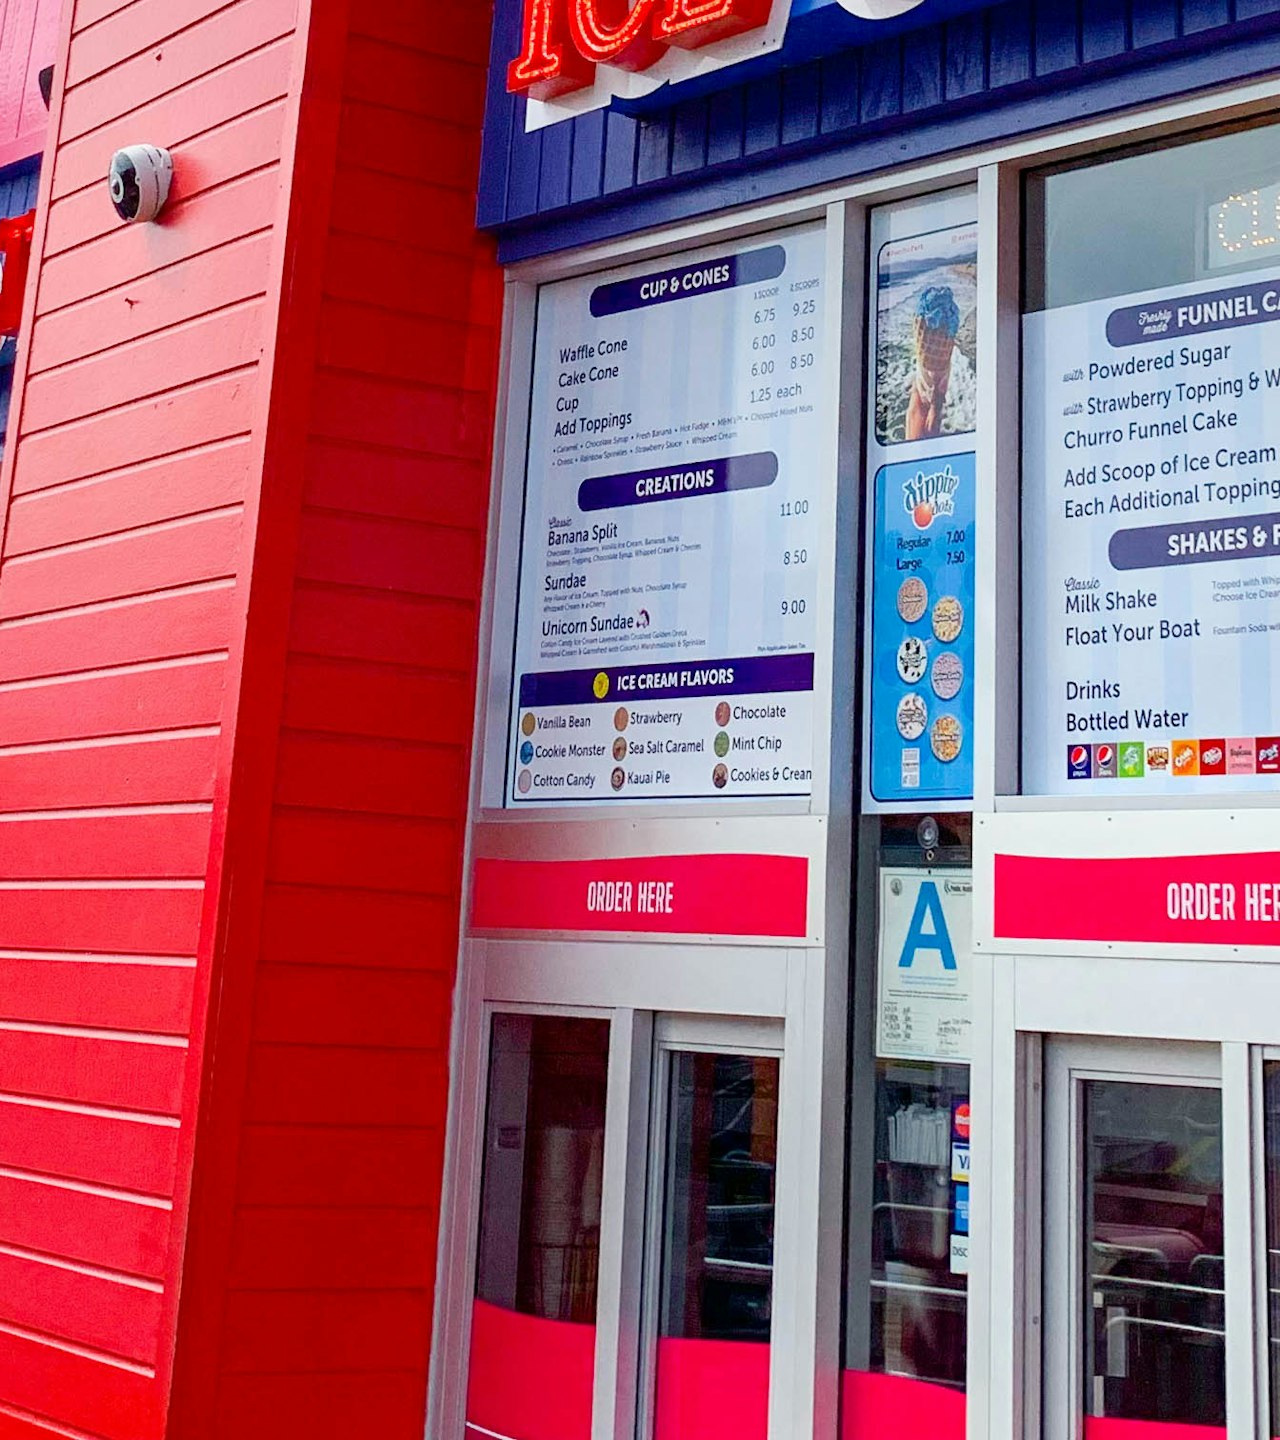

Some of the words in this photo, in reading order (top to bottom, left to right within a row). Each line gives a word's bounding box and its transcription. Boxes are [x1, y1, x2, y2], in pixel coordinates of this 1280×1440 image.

[640, 278, 667, 300] CUP
[670, 276, 679, 292] &
[682, 264, 729, 291] CONES
[1177, 295, 1258, 328] FUNNEL
[560, 347, 595, 364] Waffle
[598, 338, 628, 355] Cone
[752, 334, 775, 350] 6.00
[791, 327, 814, 342] 8.50
[751, 361, 774, 377] 6.00
[790, 354, 813, 369] 8.50
[1089, 352, 1175, 381] Powdered
[1180, 343, 1232, 371] Sugar
[558, 371, 585, 387] Cake
[588, 365, 619, 382] Cone
[556, 397, 579, 414] Cup
[750, 388, 771, 403] 1.25
[777, 383, 802, 399] each
[1087, 386, 1172, 417] Strawberry
[1175, 376, 1244, 406] Topping
[1248, 372, 1260, 391] &
[554, 422, 576, 437] Add
[580, 411, 632, 433] Toppings
[1064, 427, 1123, 450] Churro
[1128, 418, 1188, 442] Funnel
[1191, 410, 1238, 433] Cake
[1063, 468, 1097, 488] Add
[1101, 460, 1155, 487] Scoop
[1160, 456, 1180, 475] of
[1184, 452, 1209, 473] Ice
[1215, 444, 1277, 469] Cream
[636, 469, 714, 497] CREATIONS
[1064, 497, 1105, 519] Each
[1109, 488, 1199, 514] Additional
[548, 530, 589, 546] Banana
[592, 523, 618, 543] Split
[1167, 528, 1247, 557] SHAKES
[1252, 525, 1267, 547] &
[783, 549, 807, 565] 8.50
[544, 573, 586, 591] Sundae
[781, 599, 806, 615] 9.00
[1065, 594, 1101, 614] Milk
[1105, 590, 1157, 610] Shake
[542, 617, 587, 637] Unicorn
[590, 612, 634, 631] Sundae
[1065, 624, 1107, 647] Float
[1112, 623, 1155, 643] Your
[1159, 618, 1201, 639] Boat
[617, 675, 635, 691] ICE
[638, 671, 678, 690] CREAM
[680, 668, 734, 687] FLAVORS
[1066, 679, 1120, 700] Drinks
[733, 706, 786, 720] Chocolate
[1066, 711, 1129, 733] Bottled
[1135, 709, 1189, 730] Water
[732, 736, 755, 751] Mint
[758, 736, 782, 752] Chip
[587, 881, 627, 915] ORDER
[631, 881, 674, 915] HERE
[1167, 882, 1236, 924] ORDER
[898, 881, 957, 970] A
